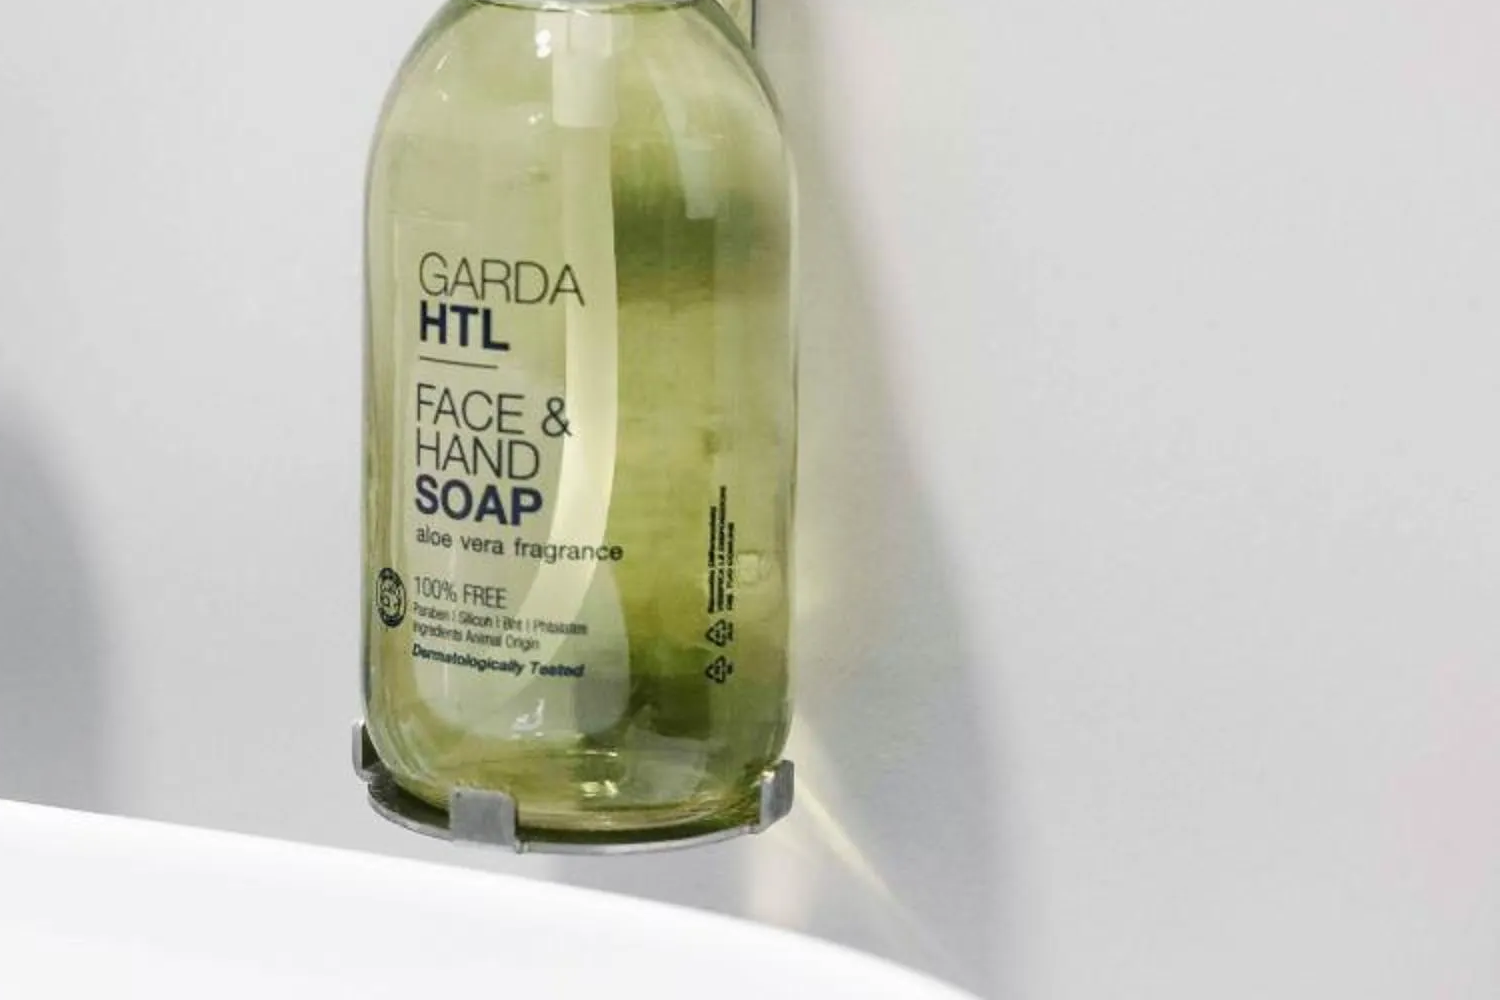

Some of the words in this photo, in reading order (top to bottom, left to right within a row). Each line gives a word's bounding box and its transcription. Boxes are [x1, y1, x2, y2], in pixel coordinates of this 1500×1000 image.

[419, 252, 585, 306] GARDA
[419, 300, 510, 351] HTL
[416, 383, 525, 435] FACE
[541, 396, 573, 438] &
[416, 427, 541, 481] HAND
[415, 474, 543, 526] SOAP
[416, 525, 453, 548] aloe
[460, 534, 505, 556] vera
[513, 538, 624, 563] fragrance
[413, 576, 457, 603] 100%
[463, 583, 507, 609] FREE
[412, 643, 527, 677] Dermatologically
